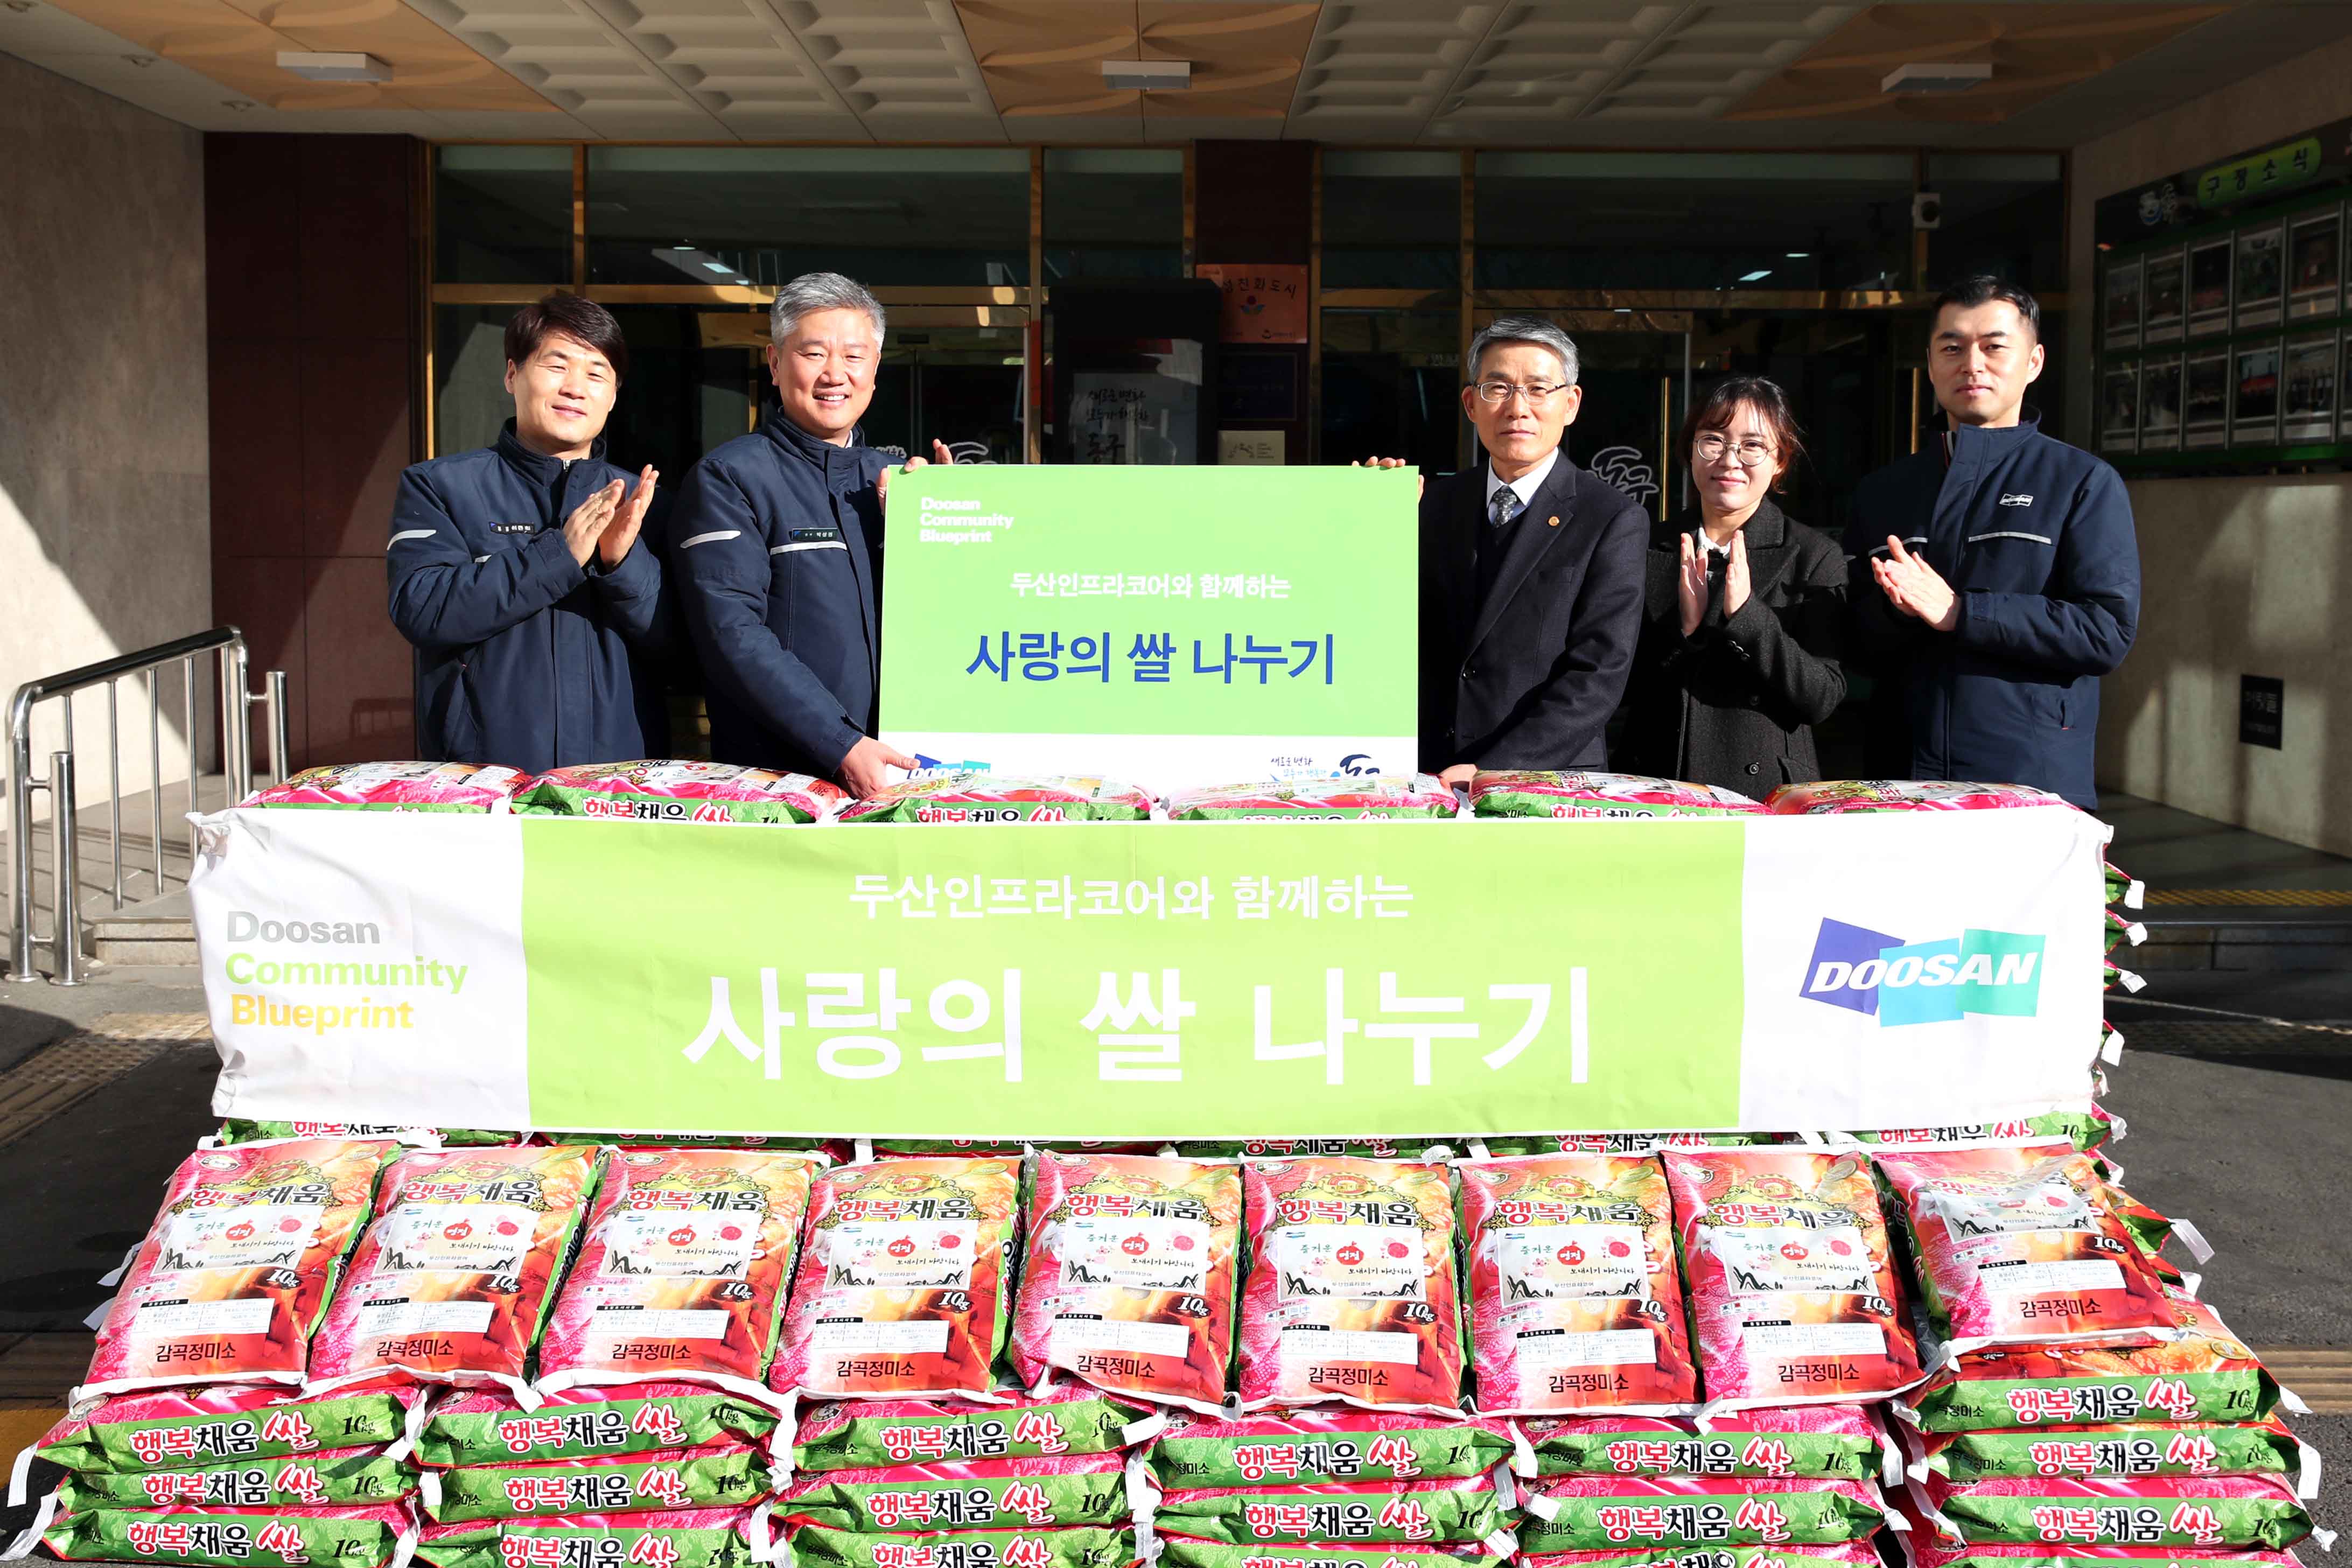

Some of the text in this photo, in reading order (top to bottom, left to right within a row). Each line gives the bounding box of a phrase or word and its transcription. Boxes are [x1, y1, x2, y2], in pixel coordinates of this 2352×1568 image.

[921, 497, 981, 510] Doosan
[921, 513, 1014, 529] Community
[920, 529, 992, 545] Blueprint
[1011, 573, 1291, 599] 두산인프라코어와 함께하는
[966, 631, 1334, 685] 사랑의 쌀 나누기
[1271, 756, 1313, 767] 새로운 변화
[849, 874, 1413, 919] 두산인프라코어와 함께하는
[226, 911, 380, 944] Doosan
[225, 953, 468, 994] Community
[1809, 952, 2038, 993] DOOSAN
[231, 994, 414, 1034] Blueprint
[681, 966, 1588, 1085] 사랑의 쌀 나누기
[191, 1185, 326, 1207] 행복채움
[404, 1181, 540, 1203] 행복채움
[628, 1190, 766, 1211] 행복채움
[836, 1199, 972, 1221] 행복채움
[1066, 1195, 1204, 1219] 행복채움
[1278, 1201, 1417, 1226] 행복채움
[1498, 1202, 1639, 1222] 행복채움
[1711, 1206, 1853, 1229] 행복채움
[2095, 1237, 2124, 1252] 10kg
[267, 1270, 299, 1287] 10kg
[487, 1274, 519, 1292] 10kg
[720, 1283, 752, 1299] 10kg
[938, 1291, 970, 1311] 10kg
[1177, 1297, 1208, 1317] 10kg
[1403, 1303, 1436, 1322] 10kg
[1638, 1301, 1667, 1321] 10kg
[1861, 1296, 1892, 1315] 10kg
[2021, 1300, 2102, 1318] 감곡정미소
[156, 1343, 236, 1361] 감곡정미소
[377, 1340, 453, 1356] 감곡정미소
[613, 1345, 691, 1359] 감곡정미소
[837, 1361, 915, 1377] 감곡정미소
[1078, 1356, 1155, 1378] 감곡정미소
[1310, 1367, 1388, 1385] 감곡정미소
[1779, 1364, 1859, 1382] 감곡정미소
[1550, 1375, 1628, 1392] 감곡정미소
[2008, 1378, 2198, 1423] 행복채움 쌀
[342, 1416, 376, 1436] 10kg
[499, 1403, 688, 1452] 행복채움 쌀
[880, 1412, 1069, 1460] 행복채움 쌀
[130, 1411, 318, 1464] 행복채움 쌀
[1234, 1436, 1422, 1480] 행복채움 쌀
[1605, 1437, 1797, 1476] 행복채움 쌀
[2029, 1432, 2220, 1476] 행복채움 쌀
[1175, 1462, 1210, 1475] 정미소
[143, 1464, 329, 1504] 행복채움 쌀
[354, 1475, 384, 1495] 10kg
[505, 1467, 692, 1511] 행복채움 쌀
[867, 1481, 1056, 1526] 행복채움 쌀
[1245, 1499, 1433, 1539] 행복채움 쌀
[1598, 1499, 1790, 1541] 행복채움 쌀
[2032, 1507, 2164, 1542] 행복채움
[2169, 1503, 2224, 1544] 쌀
[127, 1521, 310, 1562] 행복채움 쌀
[629, 1534, 680, 1568] 쌀
[1003, 1536, 1053, 1568] 쌀
